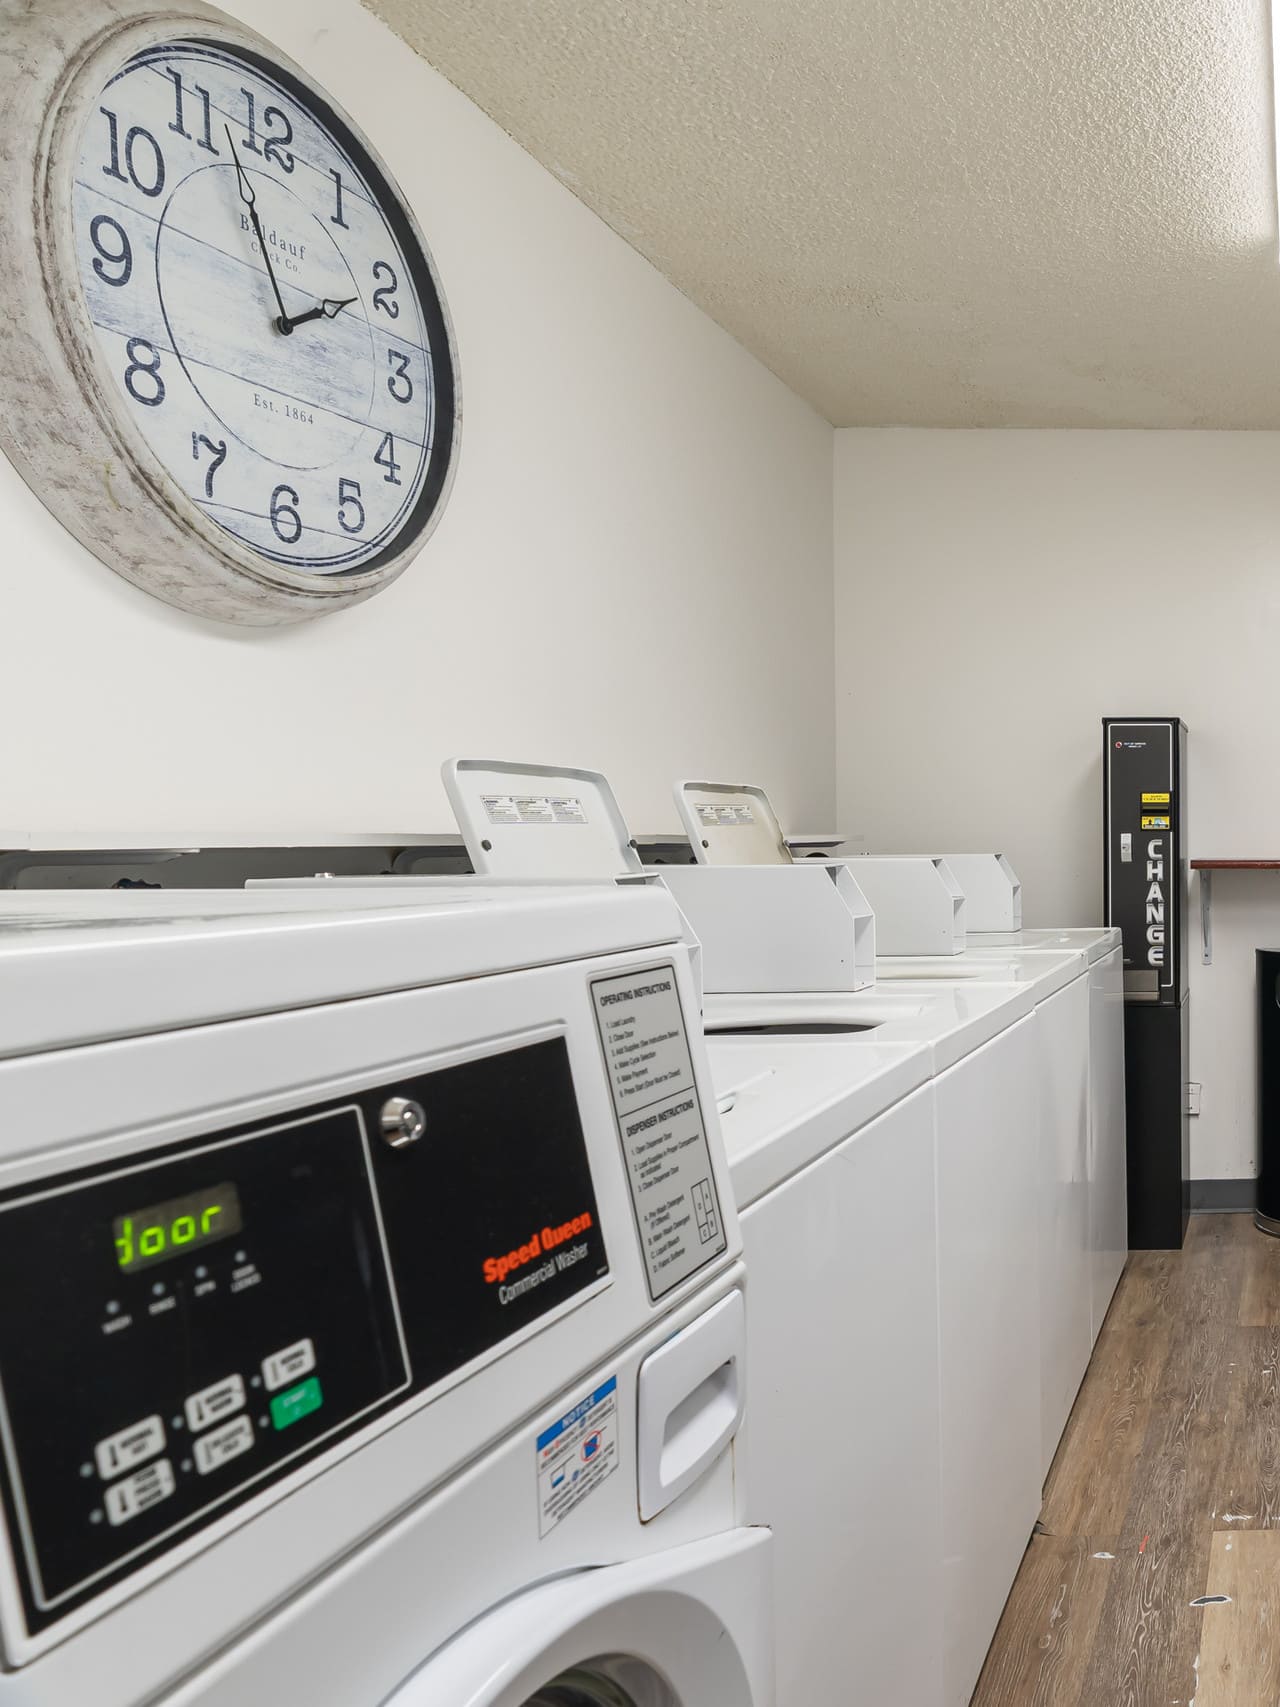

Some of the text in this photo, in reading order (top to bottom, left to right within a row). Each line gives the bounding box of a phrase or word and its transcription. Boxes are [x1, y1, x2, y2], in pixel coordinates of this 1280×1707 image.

[168, 66, 219, 156] 11
[240, 88, 295, 174] 12
[100, 106, 165, 198] 10
[330, 168, 349, 230] 1
[90, 215, 133, 287] 9
[251, 241, 280, 264] Clck
[373, 260, 399, 319] 2
[123, 337, 165, 406] 8
[387, 350, 413, 403] 3
[254, 393, 313, 424] Est. 1864
[192, 432, 227, 498] 7
[374, 432, 401, 485] 4
[270, 484, 302, 544] 6
[338, 478, 365, 533] 5
[1146, 839, 1165, 967] CHANGE
[600, 981, 671, 1007] OPERATING INSTRUCTIONS
[626, 1099, 694, 1137] DISPENSER INSTRUCTIONS
[482, 1211, 593, 1284] Speed Queen
[499, 1242, 588, 1305] Commercial Washer
[562, 1394, 594, 1429] NOTICE
